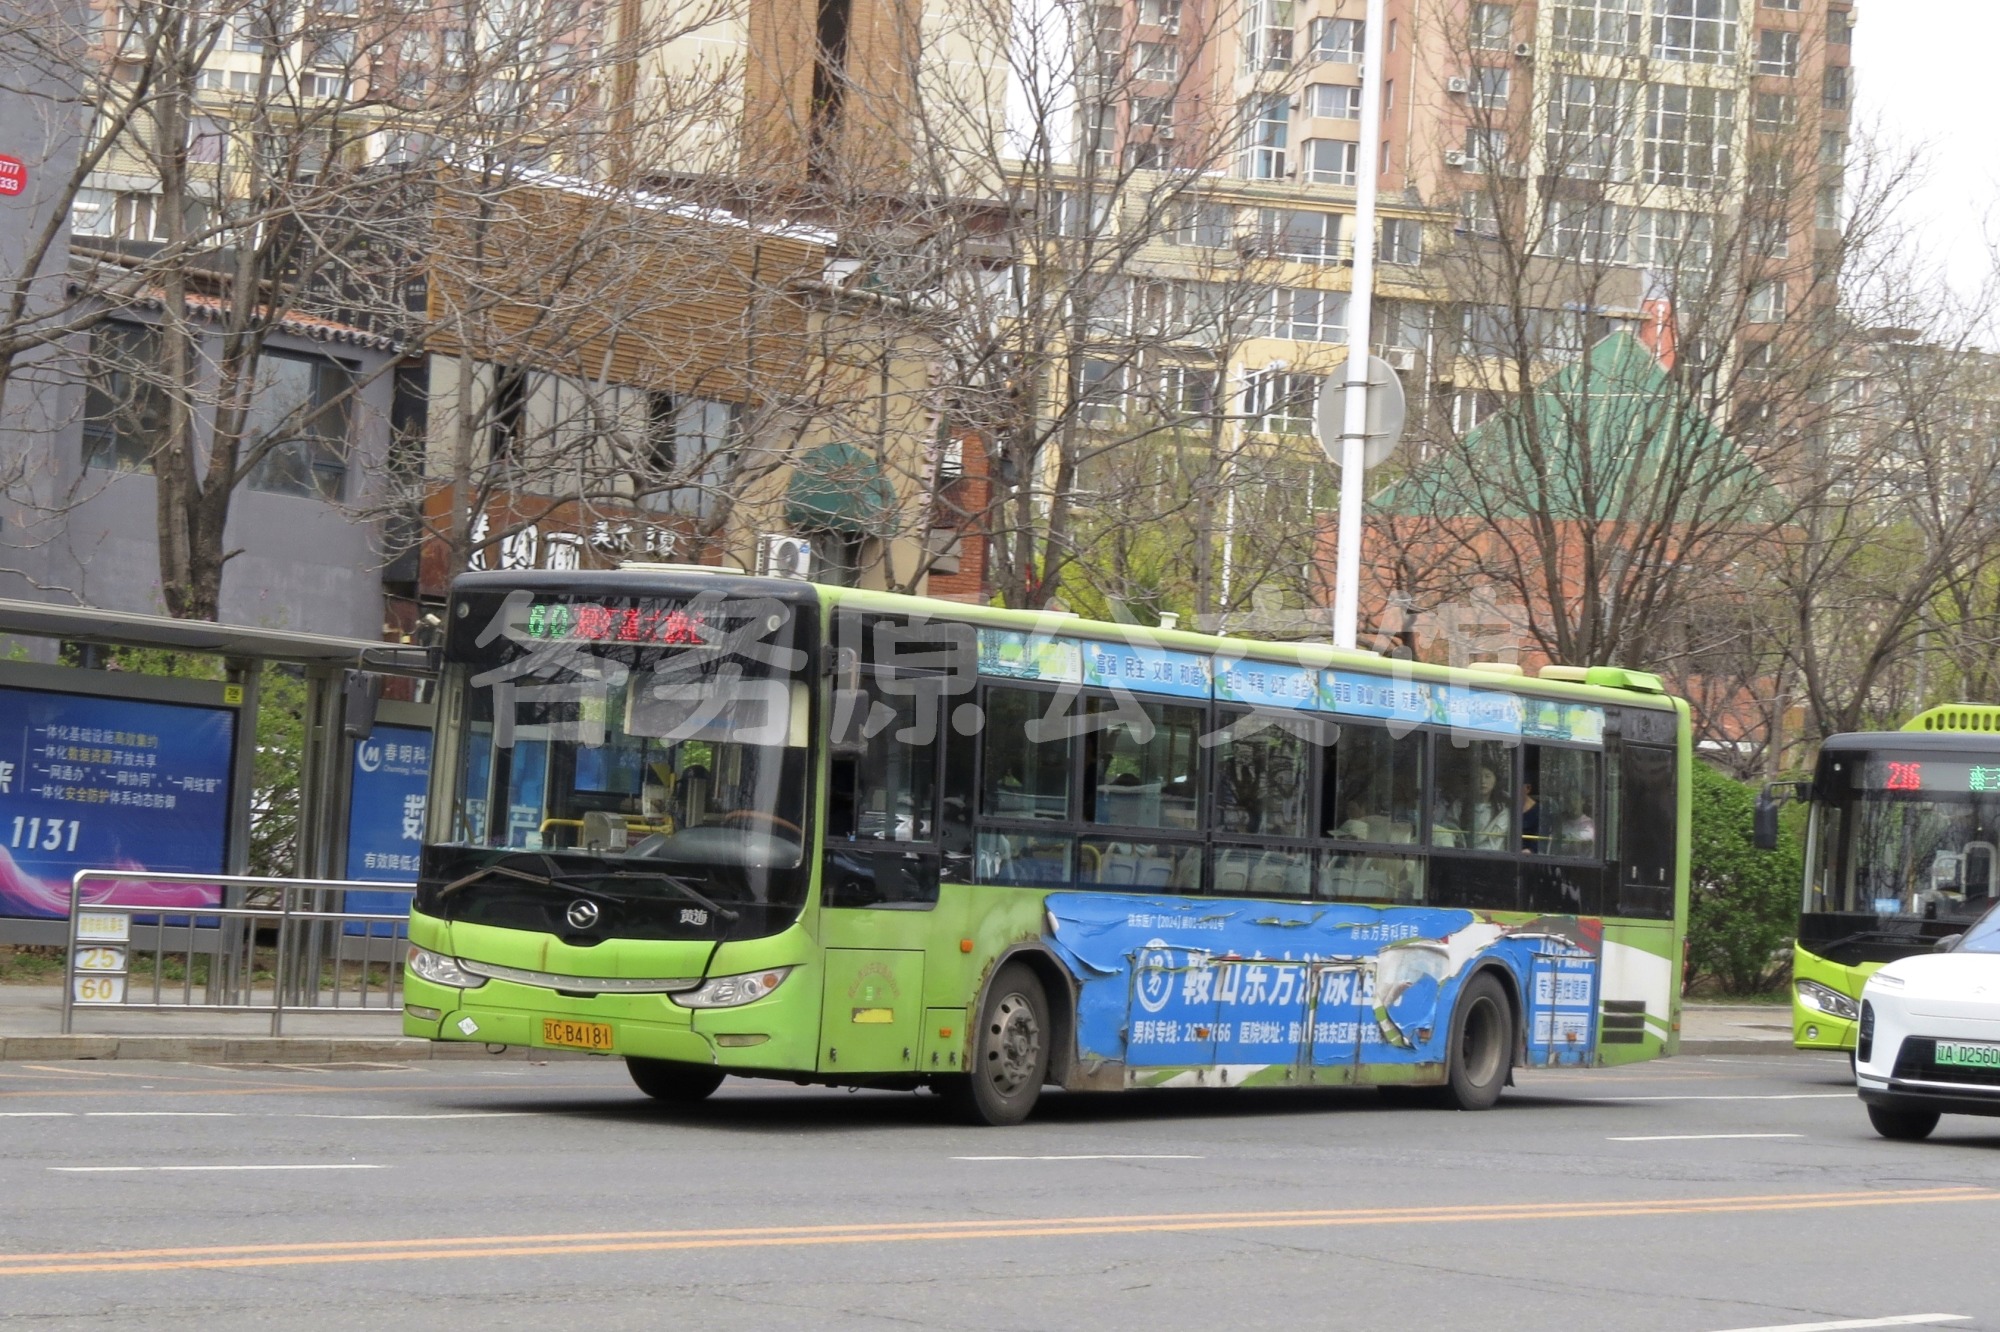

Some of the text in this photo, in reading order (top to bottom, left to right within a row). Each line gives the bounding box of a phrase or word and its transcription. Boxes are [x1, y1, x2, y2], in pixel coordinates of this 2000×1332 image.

[528, 604, 568, 639] 60
[1125, 657, 1145, 679] 民主
[1153, 661, 1173, 682] 文明
[1180, 664, 1200, 687] 和谐
[384, 743, 431, 765] 春明科
[11, 816, 80, 851] 1131
[83, 947, 116, 968] 25
[82, 978, 112, 1000] 60
